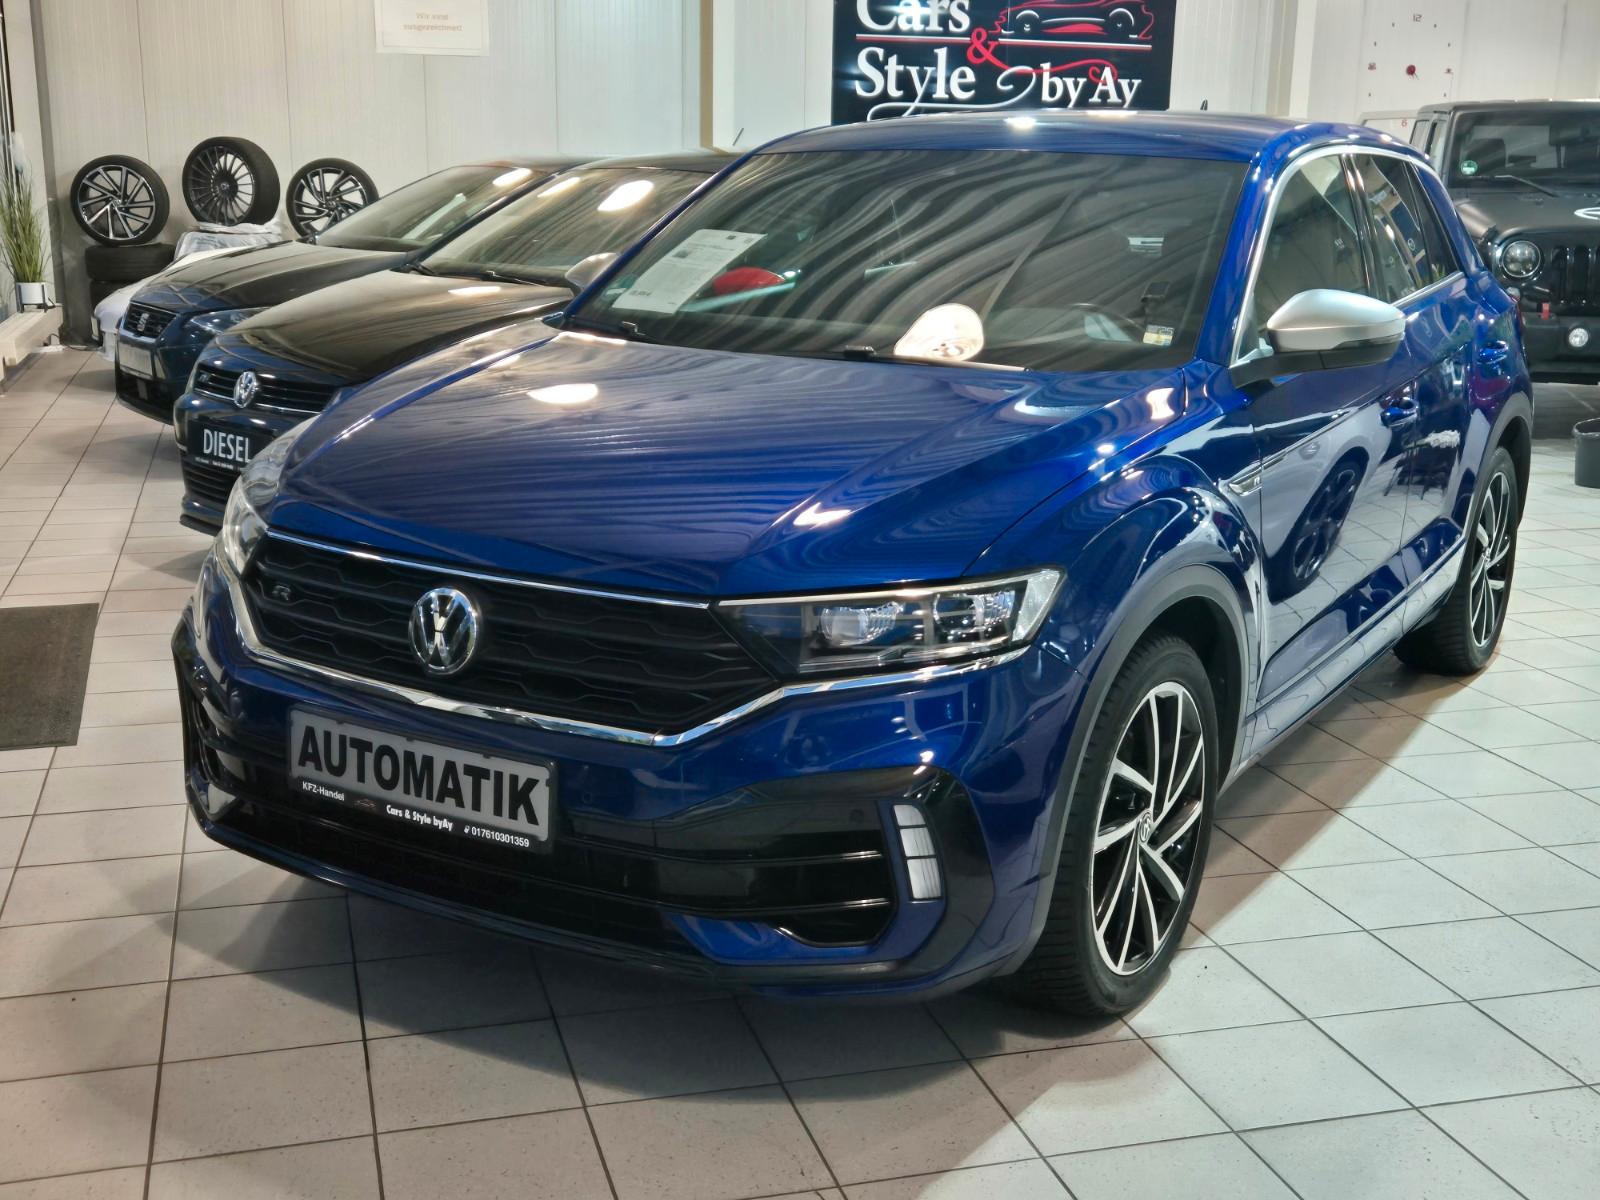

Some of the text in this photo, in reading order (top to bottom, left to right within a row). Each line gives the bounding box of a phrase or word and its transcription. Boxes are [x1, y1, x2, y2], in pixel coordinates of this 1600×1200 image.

[856, 0, 971, 32] Cars
[855, 47, 1142, 114] Style by Ay
[203, 429, 251, 464] DIESEL
[298, 725, 540, 826] AUTOMATIK
[302, 781, 345, 801] KFZ-Handel
[386, 804, 403, 817] Cars
[471, 826, 530, 848] 017610301359
